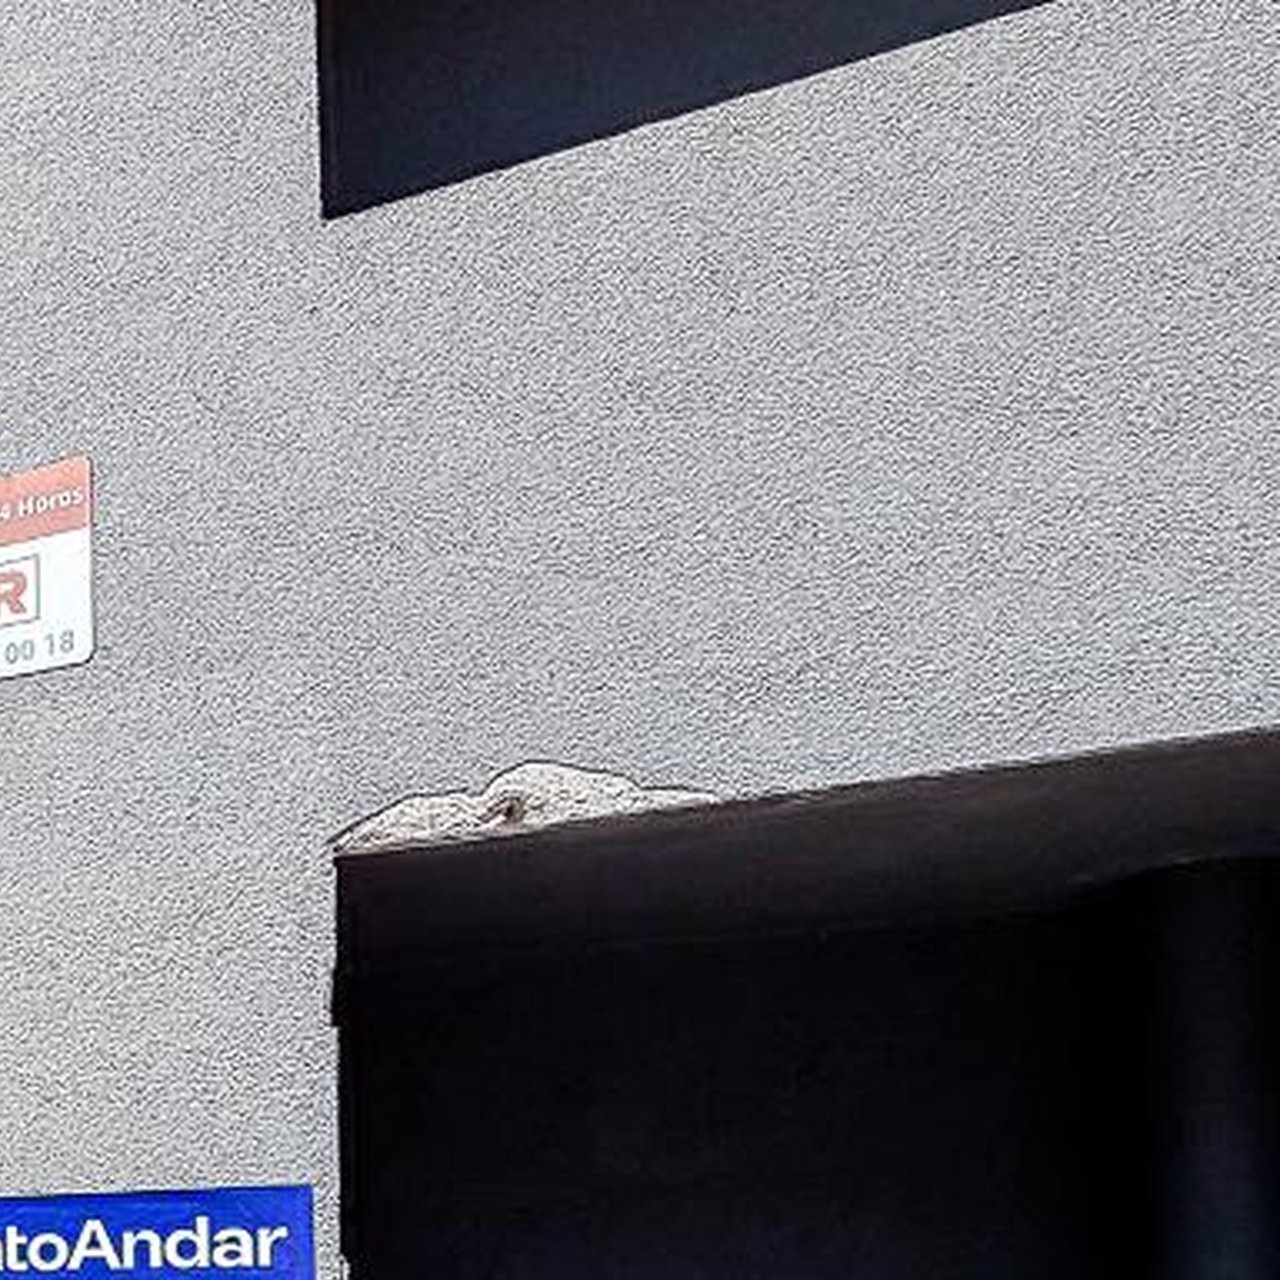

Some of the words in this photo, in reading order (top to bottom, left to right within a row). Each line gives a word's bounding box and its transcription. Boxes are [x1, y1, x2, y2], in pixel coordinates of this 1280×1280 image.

[17, 486, 85, 517] Horas
[4, 639, 35, 664] 00
[43, 629, 75, 656] 18
